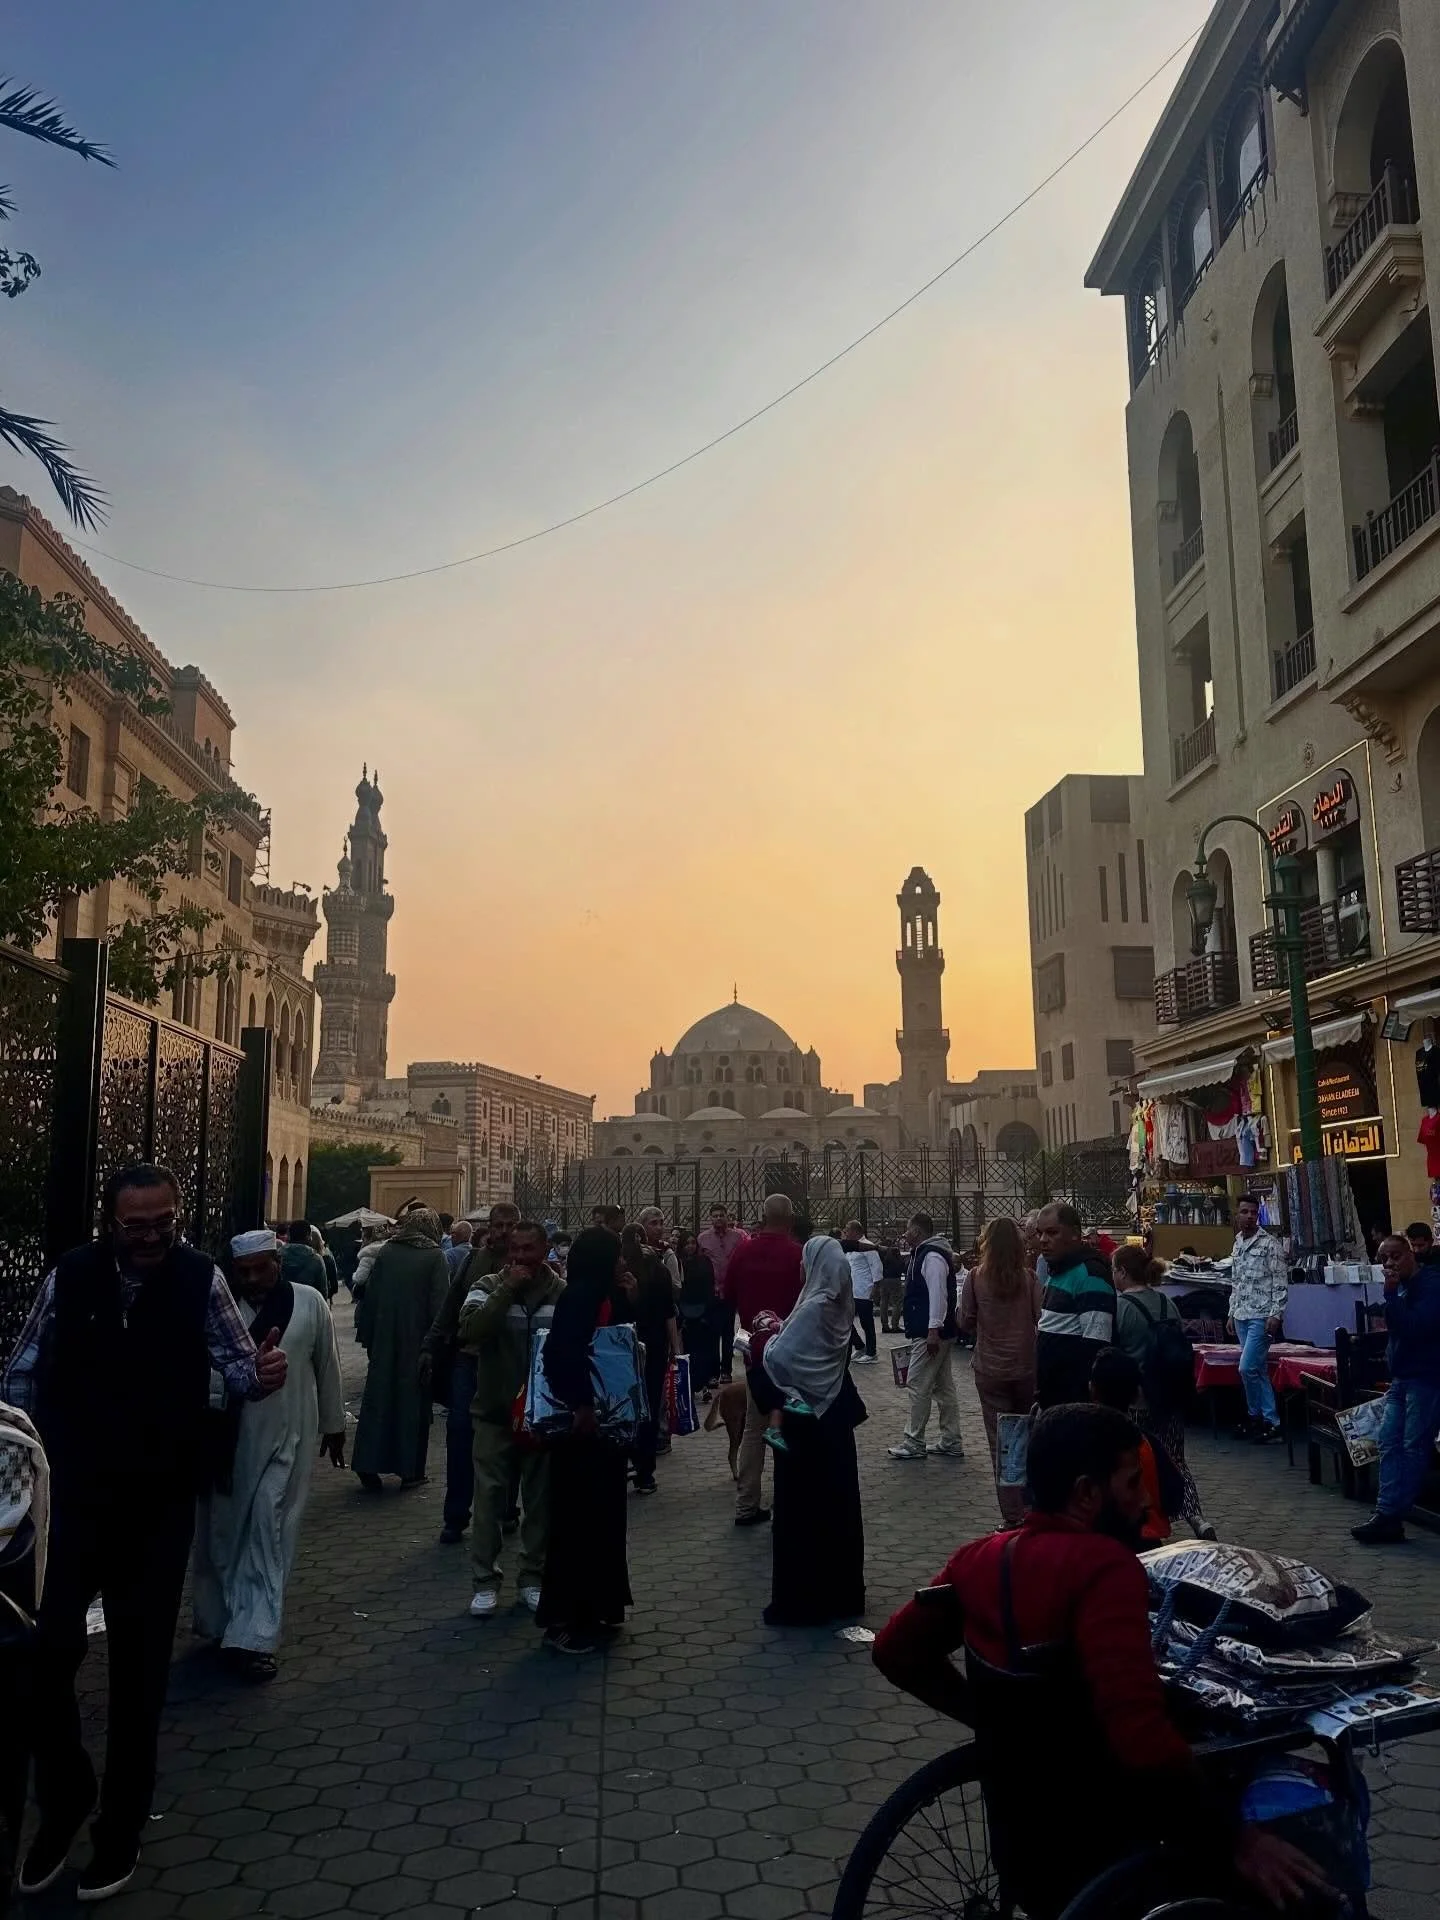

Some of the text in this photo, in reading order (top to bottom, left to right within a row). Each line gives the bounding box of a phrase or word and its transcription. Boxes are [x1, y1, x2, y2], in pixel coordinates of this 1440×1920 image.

[1312, 779, 1344, 821] الدهان
[1321, 1107, 1338, 1119] Since
[1333, 1125, 1380, 1154] الدهان
